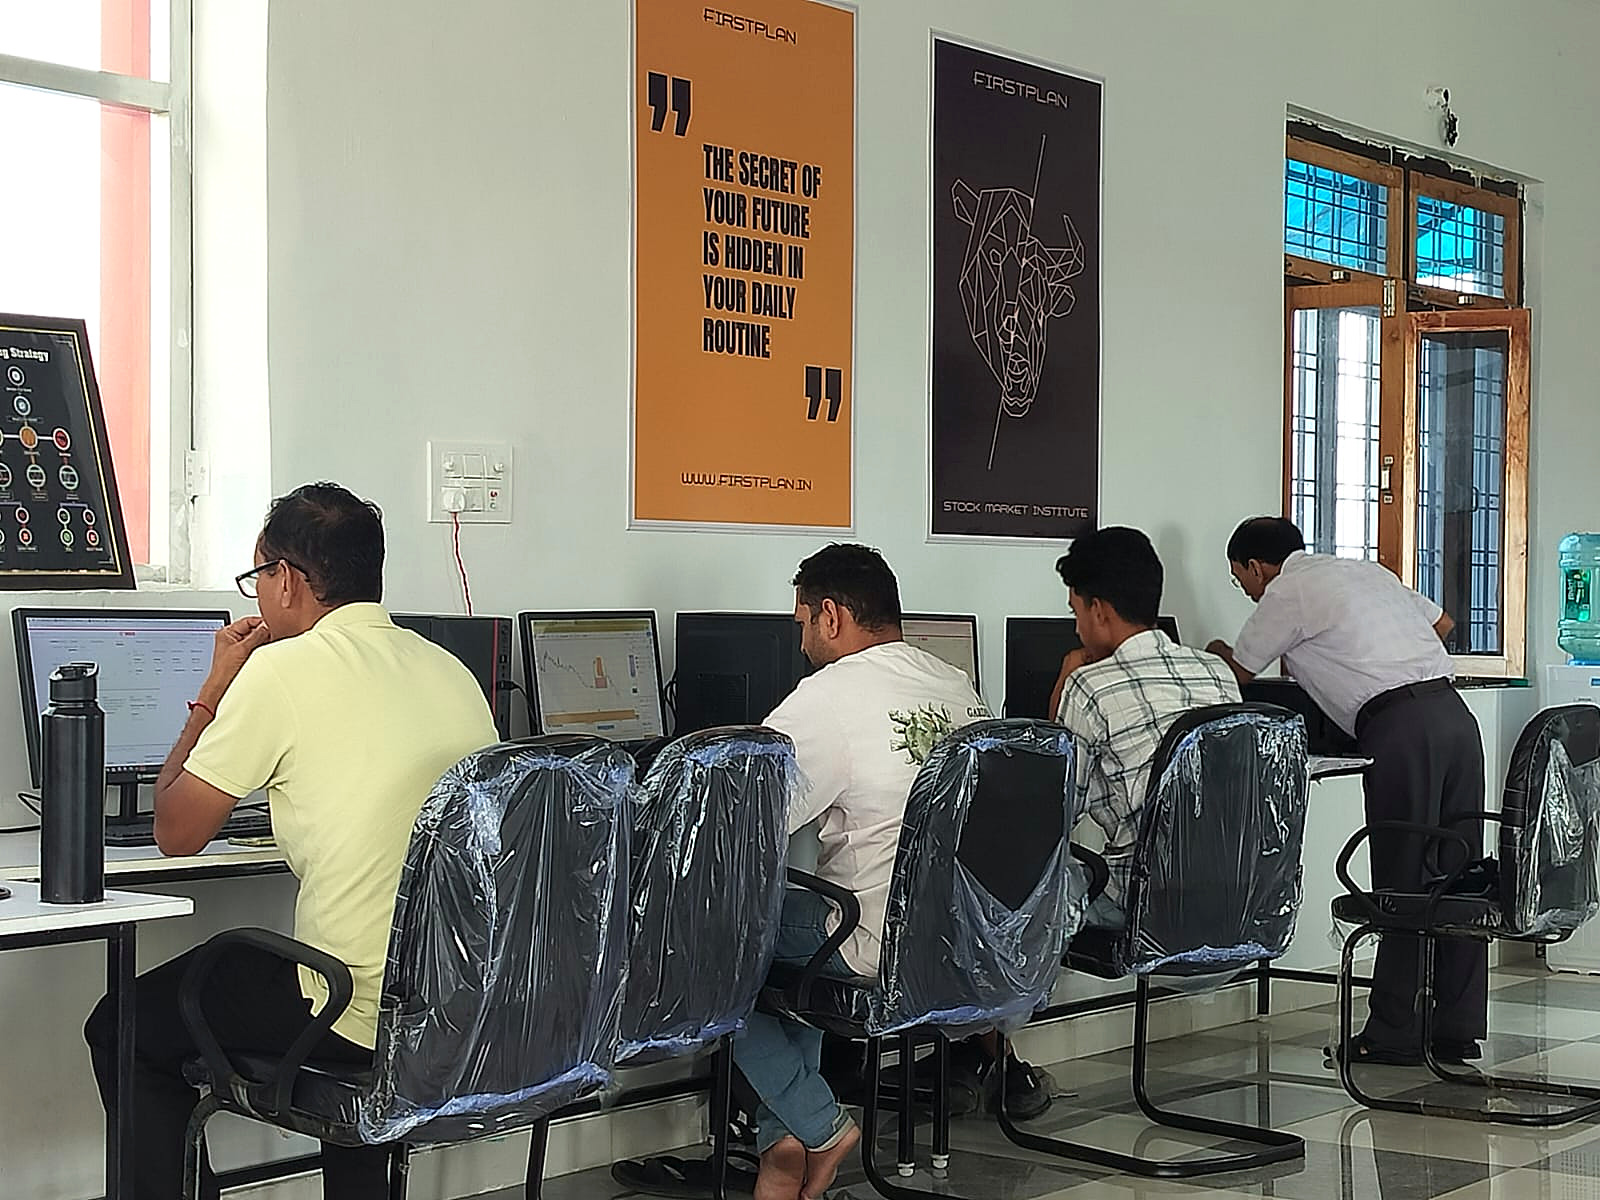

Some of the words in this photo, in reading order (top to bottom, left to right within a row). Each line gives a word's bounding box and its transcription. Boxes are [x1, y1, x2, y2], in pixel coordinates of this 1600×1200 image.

[703, 7, 797, 45] FIRSTPLAN
[973, 71, 1069, 109] FIRSTPLAN
[703, 143, 734, 183] THE
[738, 151, 798, 195] SECRET
[801, 164, 822, 199] OF
[703, 187, 747, 228] YOUR
[752, 196, 810, 239] FUTURE
[703, 230, 720, 266] IS
[724, 234, 784, 277] HIDDEN
[788, 244, 804, 280] IN
[703, 274, 747, 313] YOUR
[751, 281, 796, 320] DAILY
[703, 317, 771, 359] ROUTINE
[681, 472, 813, 491] WWW.FIRSTPLAN.IN
[943, 501, 981, 513] STOCK
[984, 503, 1029, 515] MARKET
[1032, 505, 1089, 518] INSTITUTE
